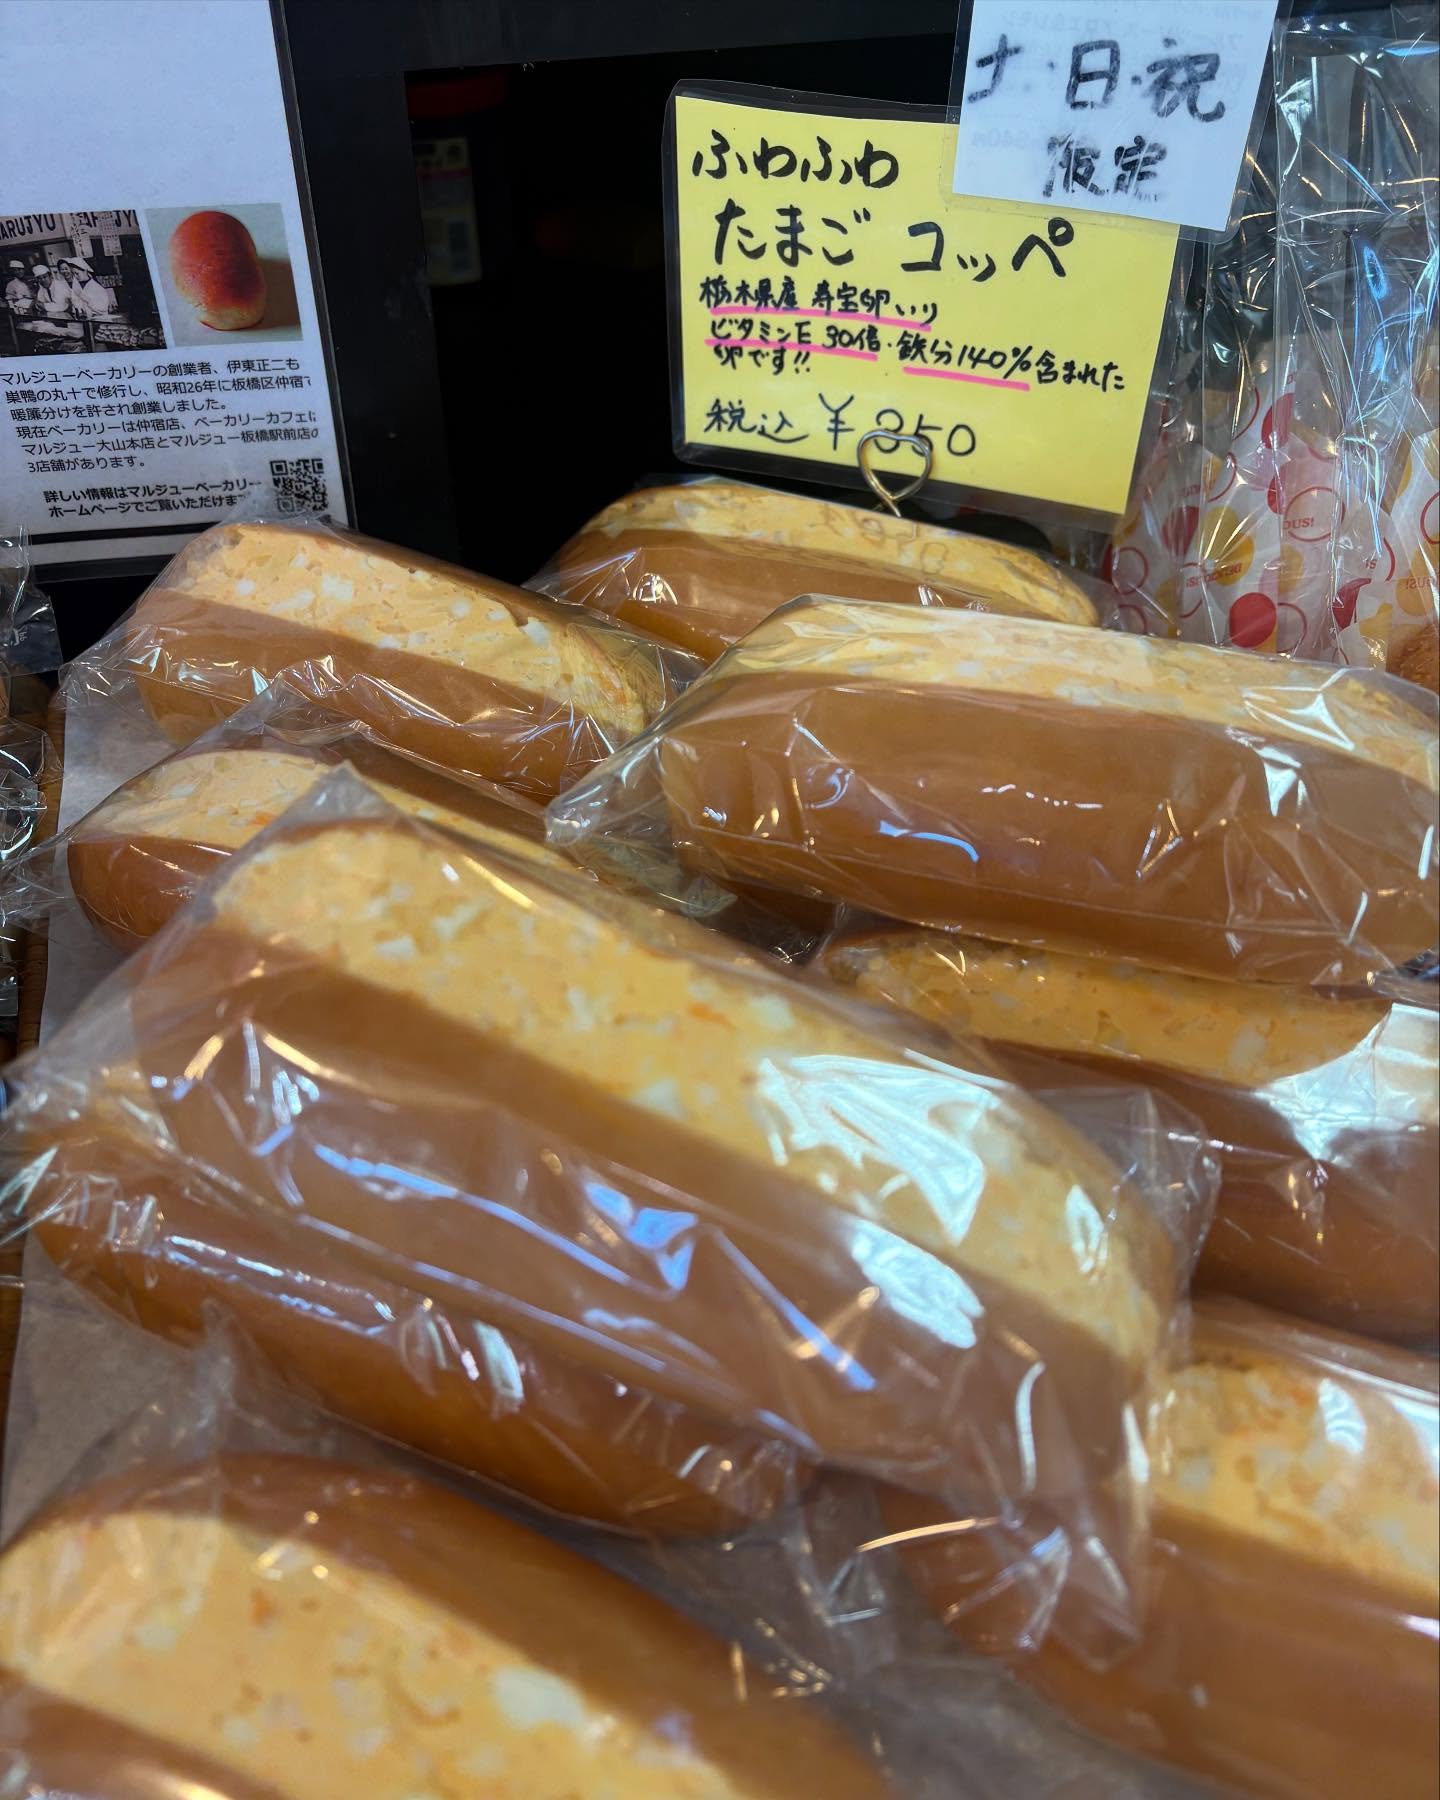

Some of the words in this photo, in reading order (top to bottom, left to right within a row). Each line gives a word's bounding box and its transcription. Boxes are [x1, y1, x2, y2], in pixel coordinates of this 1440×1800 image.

[692, 130, 899, 188] ふわふわ
[715, 199, 871, 267] たまご
[901, 217, 1074, 282] コッペ
[0, 358, 300, 385] マルジューベーカリーの創業者、伊東正二も
[10, 398, 226, 422] 暖簾分けを許され創業しました。
[28, 456, 145, 473] 3店舗があります。
[49, 494, 246, 517] ホームページでご覧いただけま
